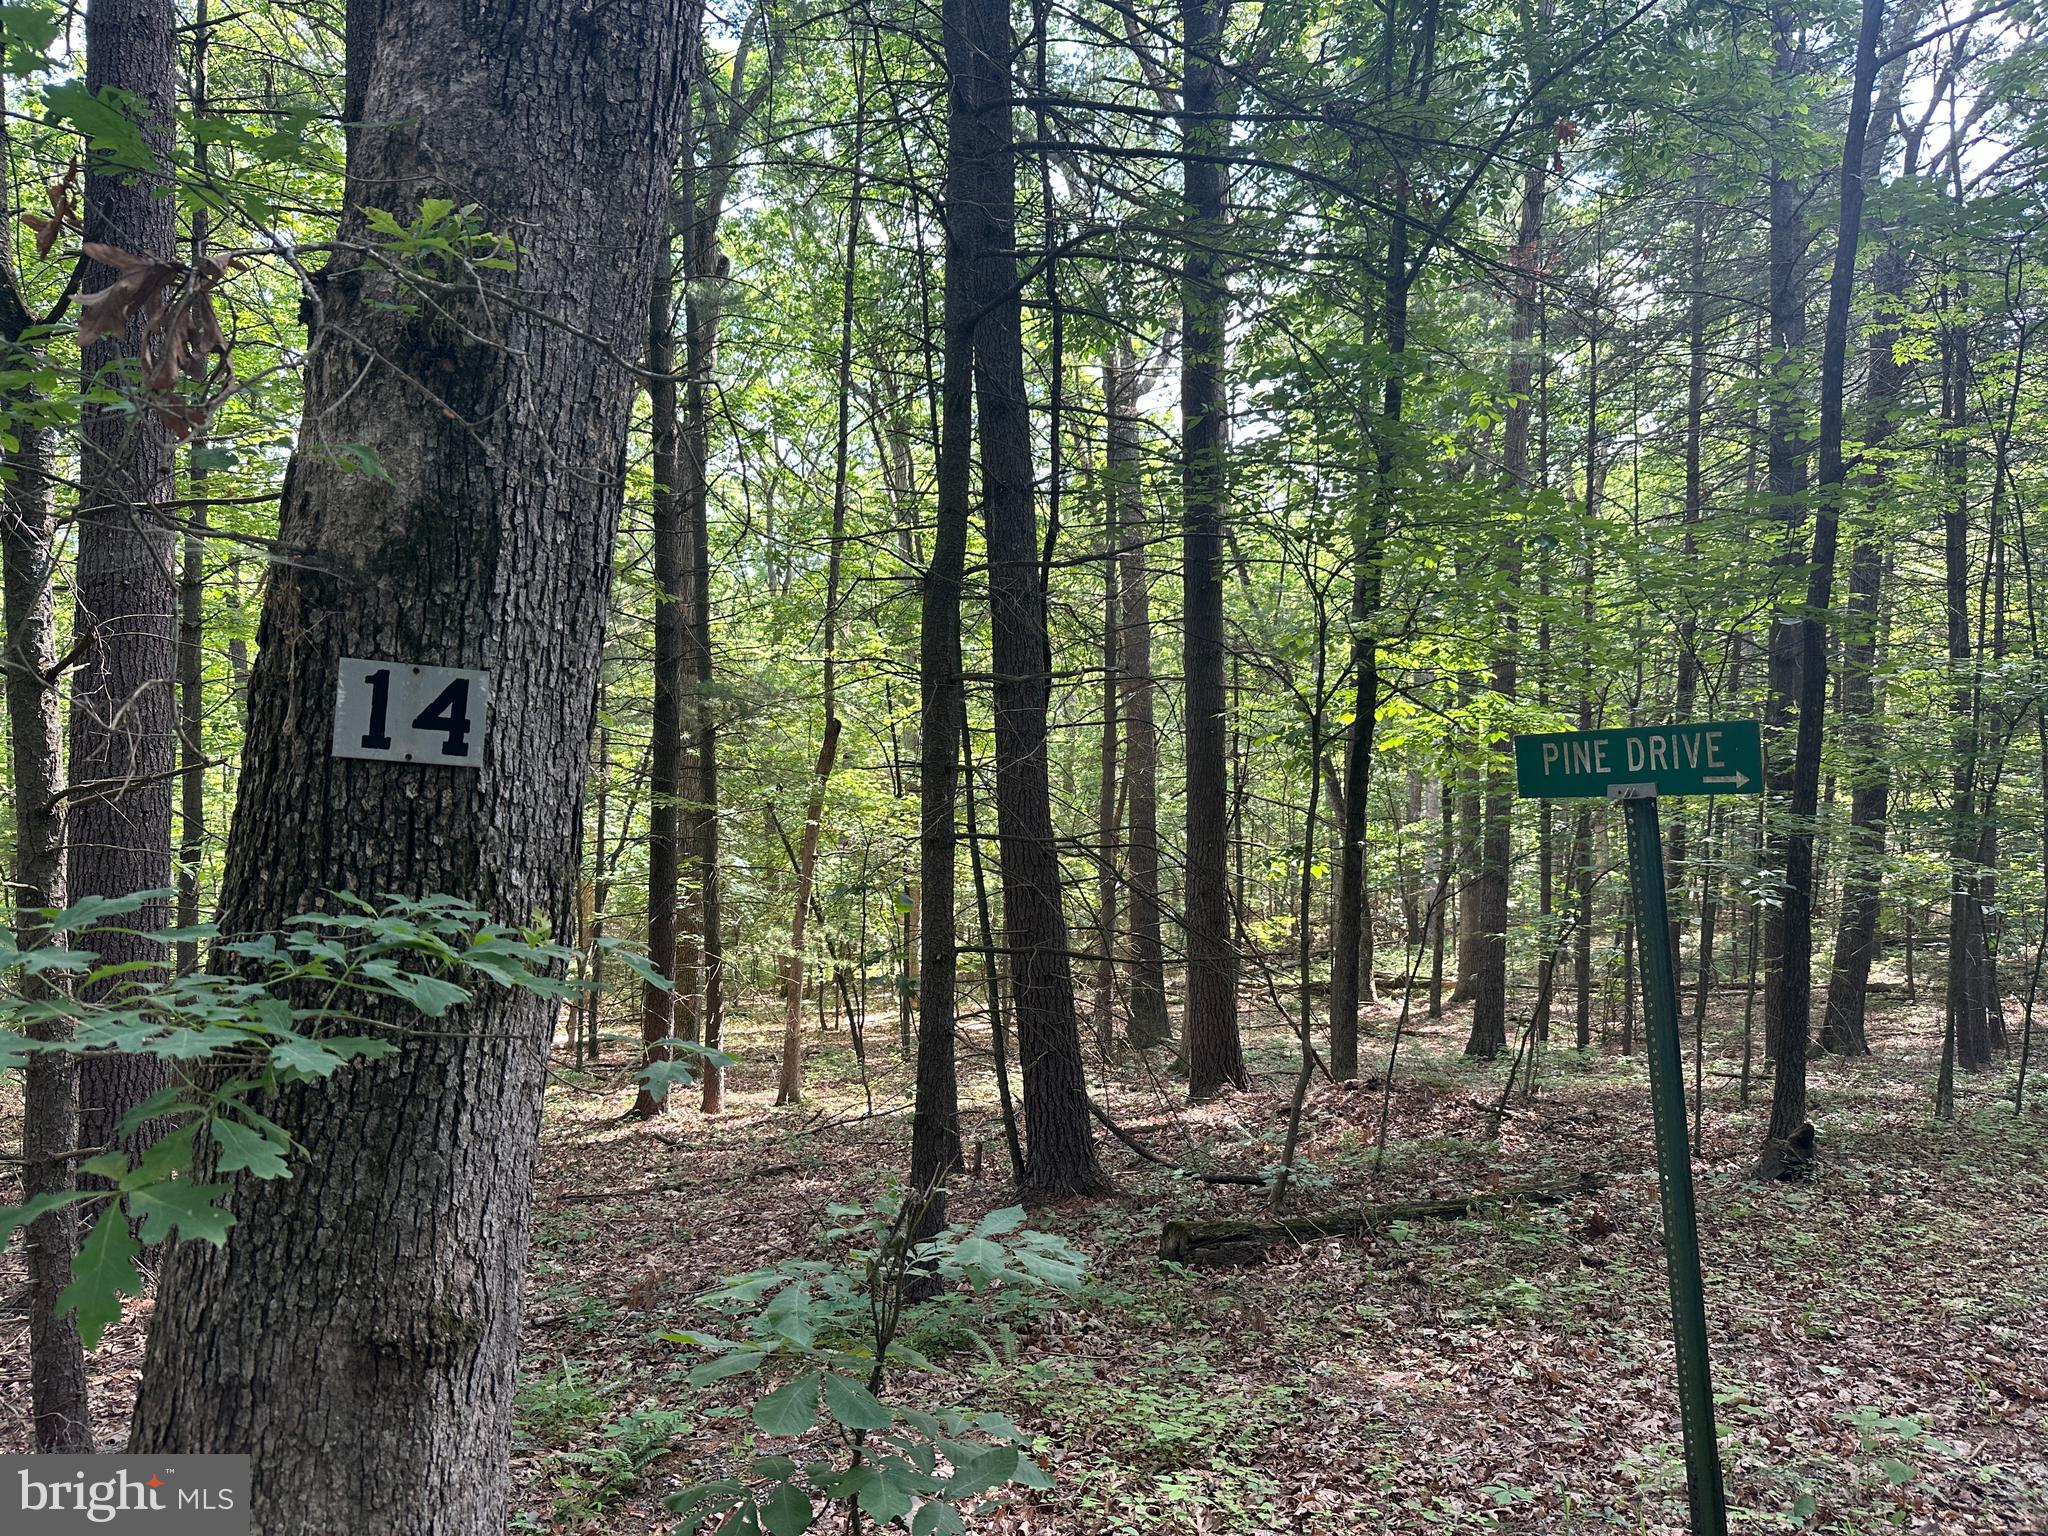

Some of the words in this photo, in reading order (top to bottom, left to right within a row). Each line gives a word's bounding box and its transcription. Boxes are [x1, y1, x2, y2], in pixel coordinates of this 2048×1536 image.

[361, 669, 470, 756] 14
[1542, 739, 1611, 776] PINE
[1626, 731, 1725, 772] DRIVE
